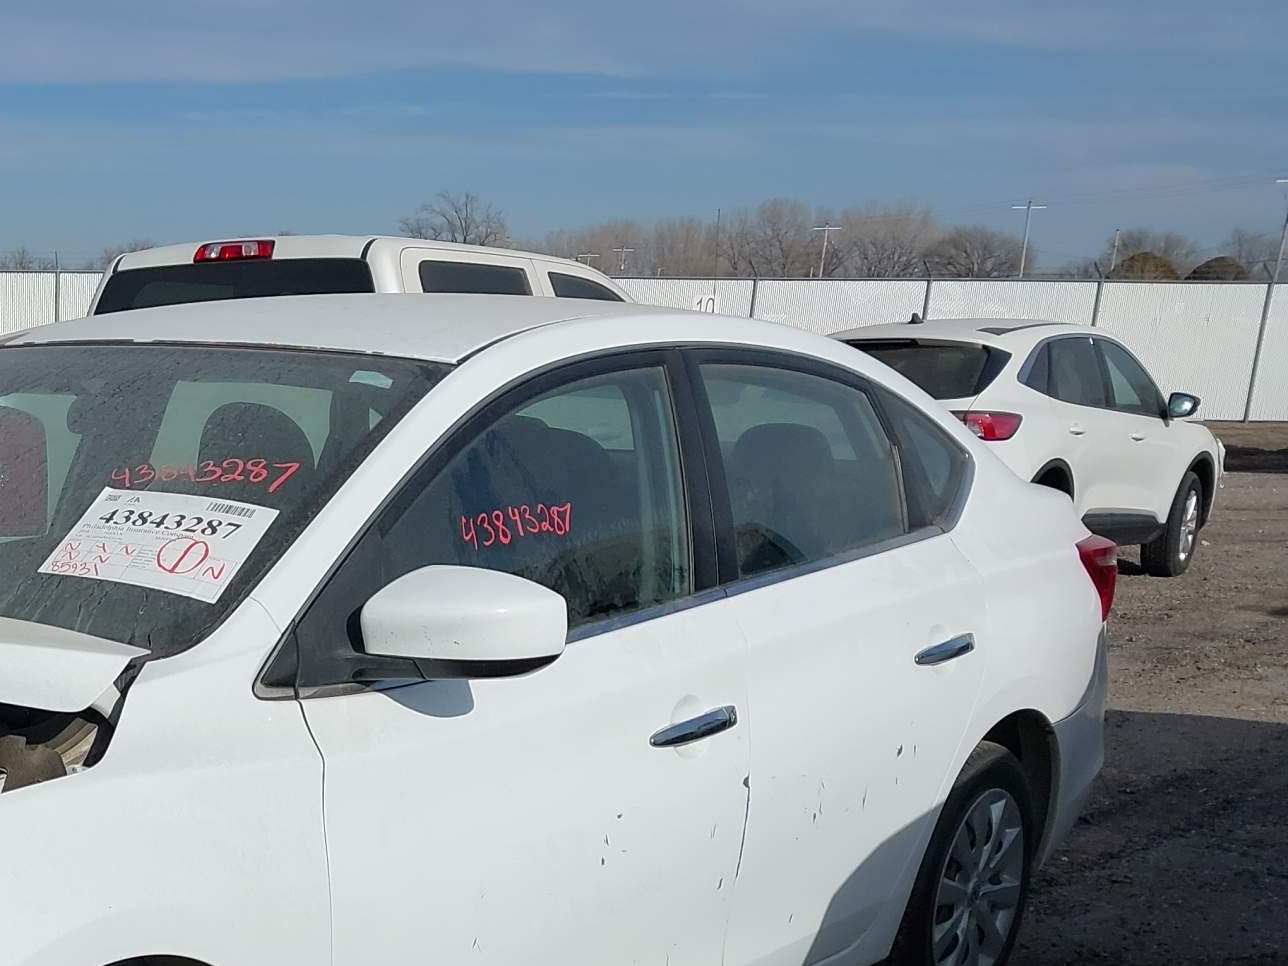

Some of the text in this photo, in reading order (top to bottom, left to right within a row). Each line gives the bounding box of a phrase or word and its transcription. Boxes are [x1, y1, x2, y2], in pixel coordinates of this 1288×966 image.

[99, 508, 243, 540] 43843287
[125, 526, 160, 535] Insurance
[460, 502, 572, 551] 43843287
